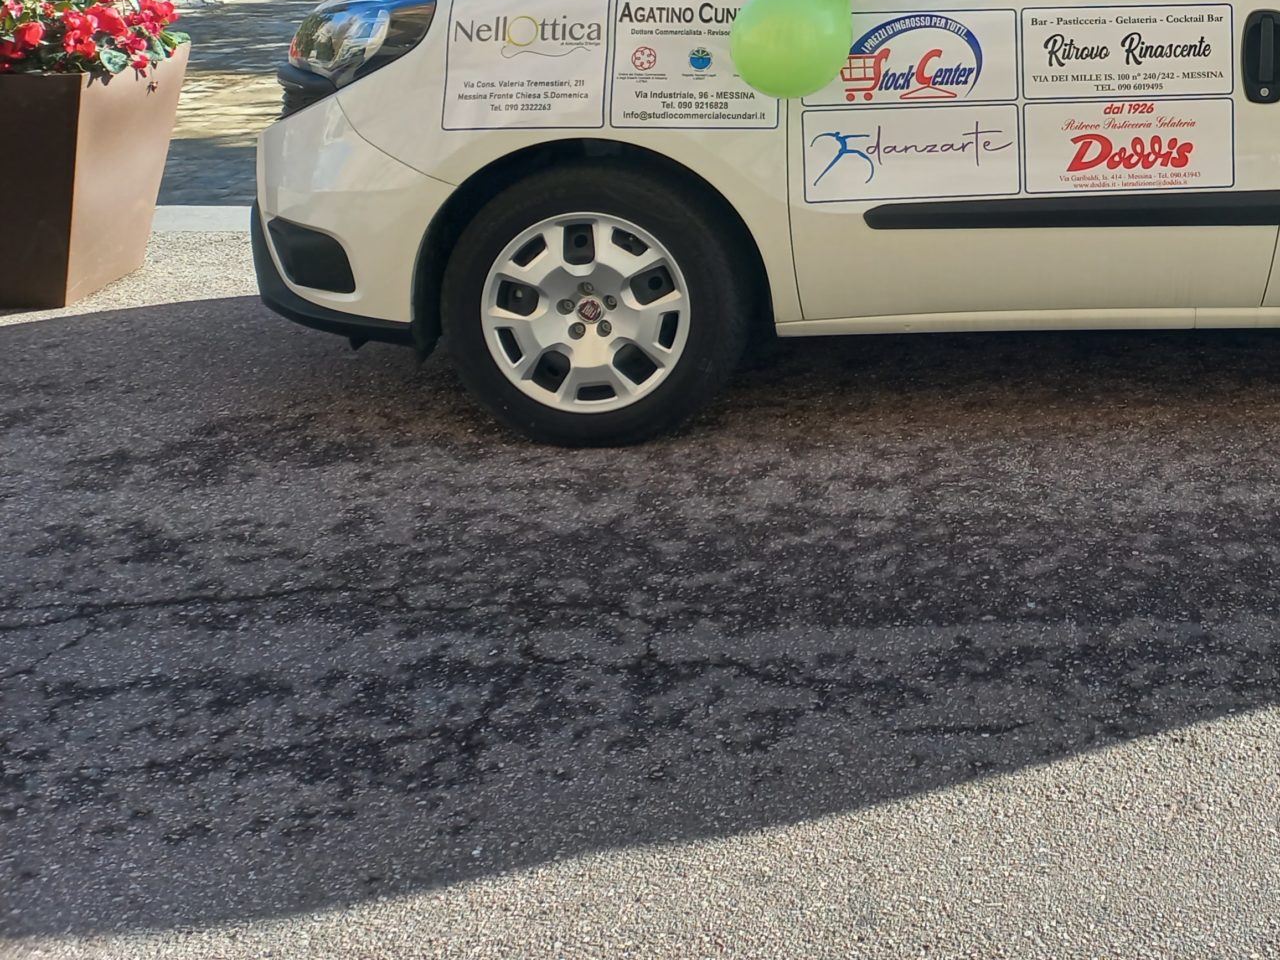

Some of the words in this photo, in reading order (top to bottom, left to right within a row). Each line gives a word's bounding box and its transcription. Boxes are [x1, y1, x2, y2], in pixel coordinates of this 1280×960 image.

[619, 2, 694, 24] AGATINO
[699, 2, 741, 24] CUN
[1031, 18, 1047, 26] Bar
[1056, 17, 1106, 26] Pasticceria
[1115, 16, 1157, 25] Gelateria
[1166, 14, 1204, 24] Cocktail
[1207, 14, 1224, 23] Bar
[655, 28, 702, 36] Commercialista
[707, 28, 731, 36] Revisor
[864, 29, 888, 52] PREZZI
[887, 16, 931, 45] D'INGROSSO
[931, 16, 946, 28] PER
[1043, 33, 1110, 67] Ritrovo
[1121, 32, 1211, 65] Rinascente
[869, 48, 915, 91] Stock
[916, 48, 975, 87] Center
[1032, 75, 1049, 83] VIA
[1051, 74, 1068, 82] DEI
[1071, 74, 1101, 82] MILLE
[1117, 73, 1130, 81] 100
[1143, 72, 1175, 81] 240/242
[1182, 71, 1224, 80] MESSINA
[463, 81, 475, 89] Via
[476, 81, 496, 89] Cons.
[498, 80, 524, 88] Valeria
[1117, 83, 1132, 91] 090
[1133, 83, 1163, 91] 6019495
[458, 92, 487, 100] Messina
[543, 91, 589, 99] S.Domenica
[635, 91, 648, 99] Via
[650, 91, 696, 100] Industriale,
[698, 91, 709, 99] 96
[716, 91, 755, 100] MESSINA
[661, 101, 676, 109] Tel.
[678, 101, 693, 109] 090
[1104, 103, 1124, 115] dal
[1127, 103, 1154, 115] 1926
[866, 120, 1013, 166] danzarte
[1066, 133, 1194, 172] Doddis
